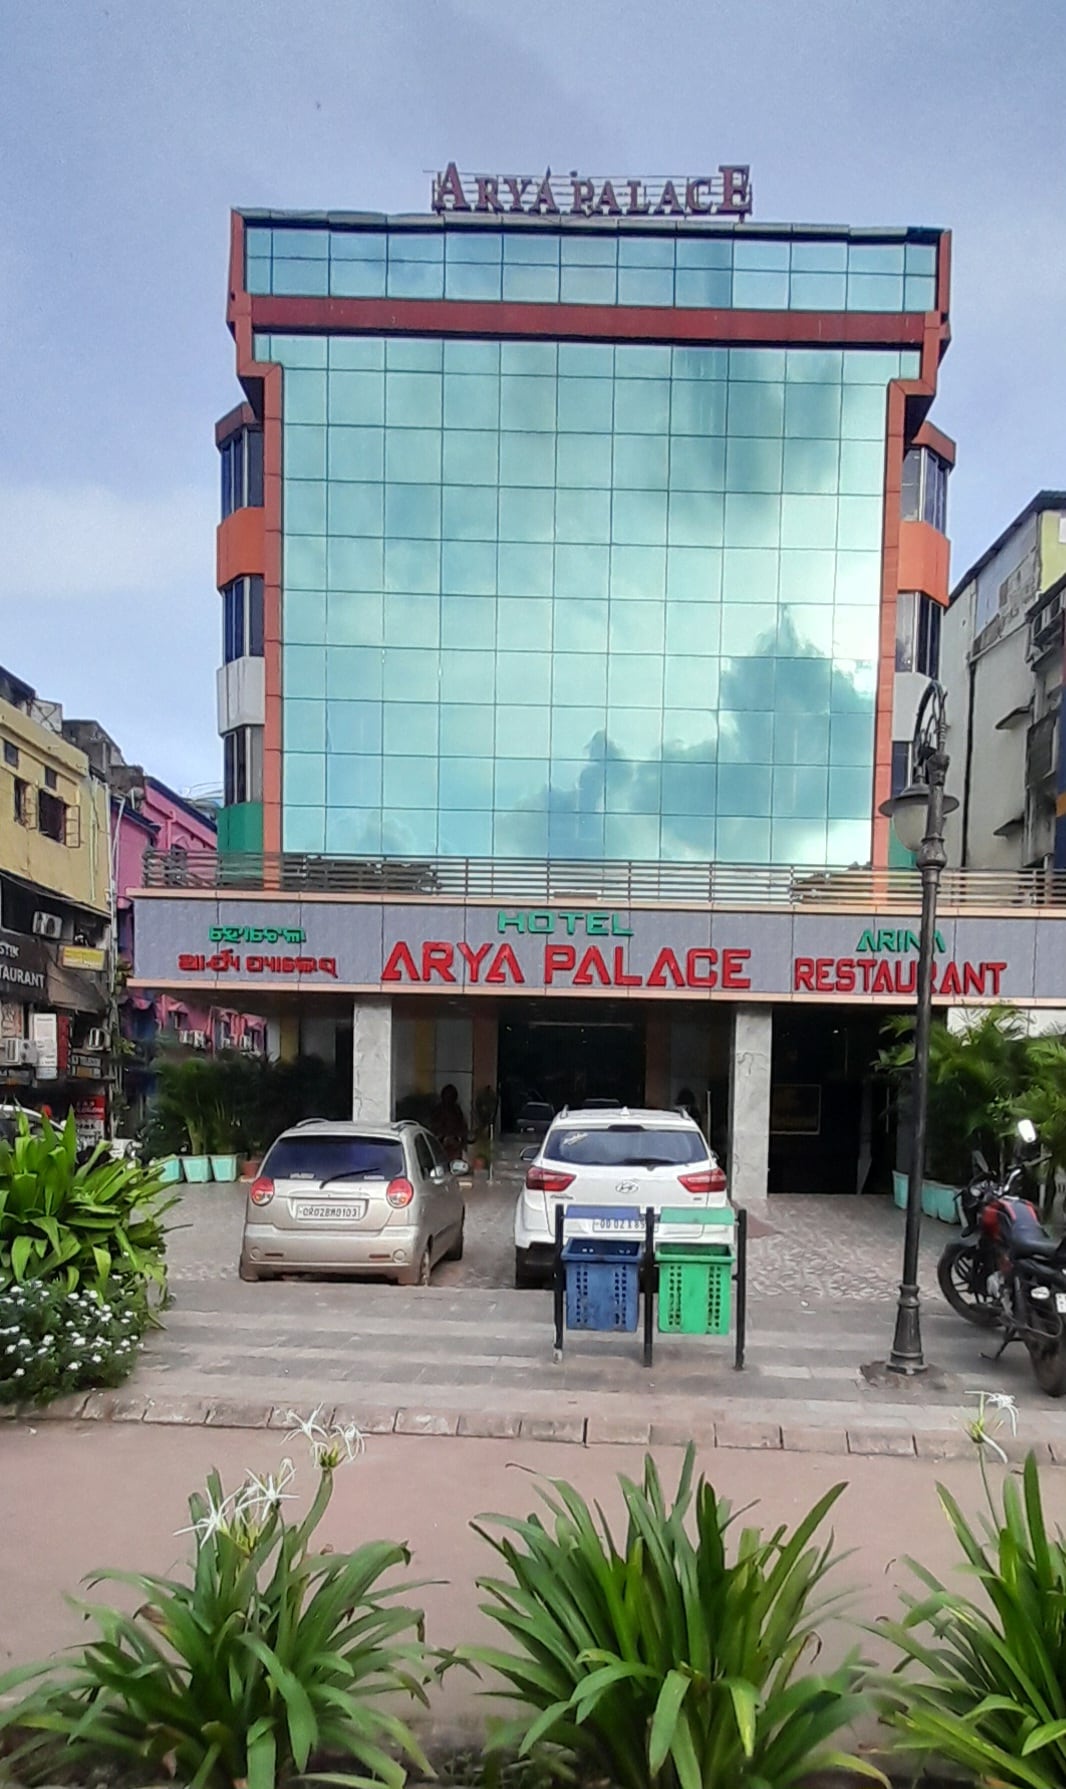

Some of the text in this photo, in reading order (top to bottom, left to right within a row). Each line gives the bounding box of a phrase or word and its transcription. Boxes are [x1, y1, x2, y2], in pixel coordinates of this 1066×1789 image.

[434, 161, 752, 215] ARYA PALACE
[497, 910, 634, 937] HOTEL
[381, 941, 752, 989] ARYA PALACE
